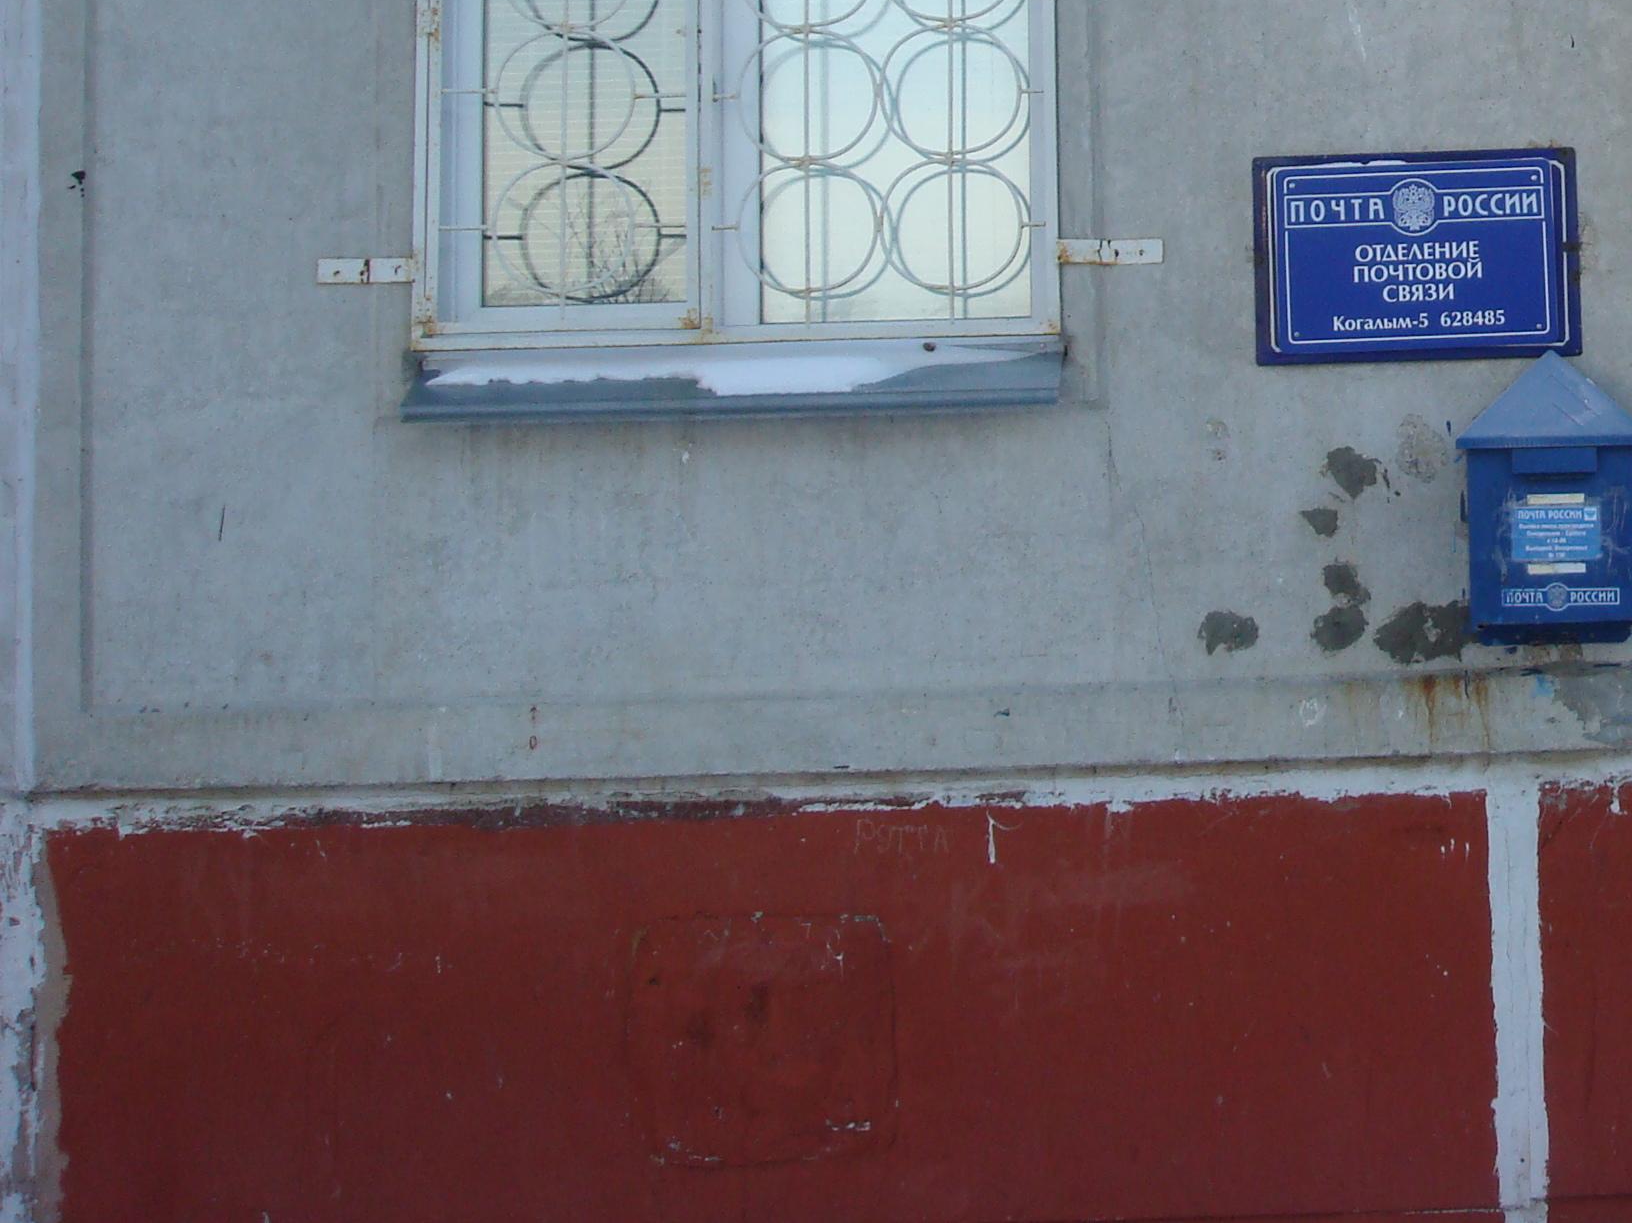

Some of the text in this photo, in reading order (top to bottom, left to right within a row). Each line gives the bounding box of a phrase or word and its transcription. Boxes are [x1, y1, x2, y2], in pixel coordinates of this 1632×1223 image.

[1290, 192, 1538, 223] ПОЧТА РОССИИ
[1354, 240, 1480, 263] ОТДЕЛЕНИЕ
[1353, 258, 1483, 283] ПОЧТОВОЙ
[1382, 283, 1455, 303] СВЯЗИ
[1332, 310, 1506, 331] Когалым-5 628485
[1517, 509, 1582, 520] ПОЧТА РОССИИ
[1506, 590, 1615, 604] ПОЧТА РОССИИ
